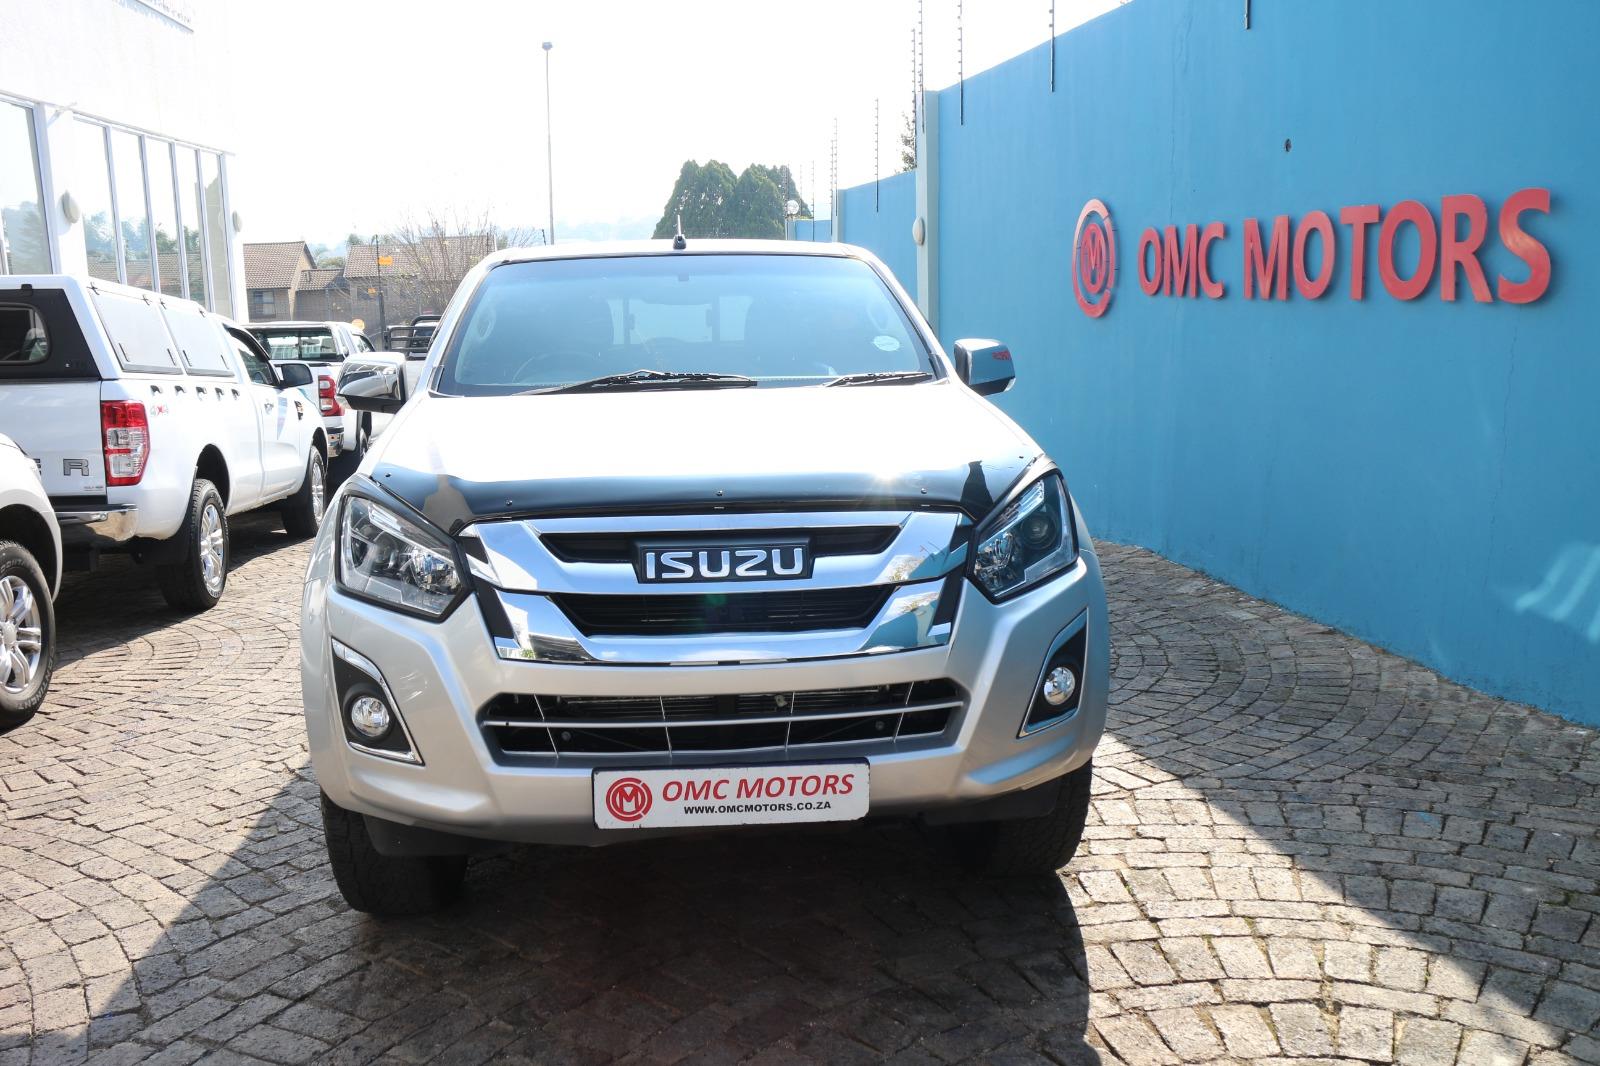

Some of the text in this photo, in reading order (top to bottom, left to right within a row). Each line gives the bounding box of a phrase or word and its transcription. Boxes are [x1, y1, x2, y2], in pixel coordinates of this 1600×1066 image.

[1138, 187, 1551, 304] OMC MOTORS
[646, 548, 803, 579] ISUZU
[662, 774, 854, 802] OMC MOTORS
[684, 802, 831, 814] WWW.OMCMOTORS.CO.ZA
